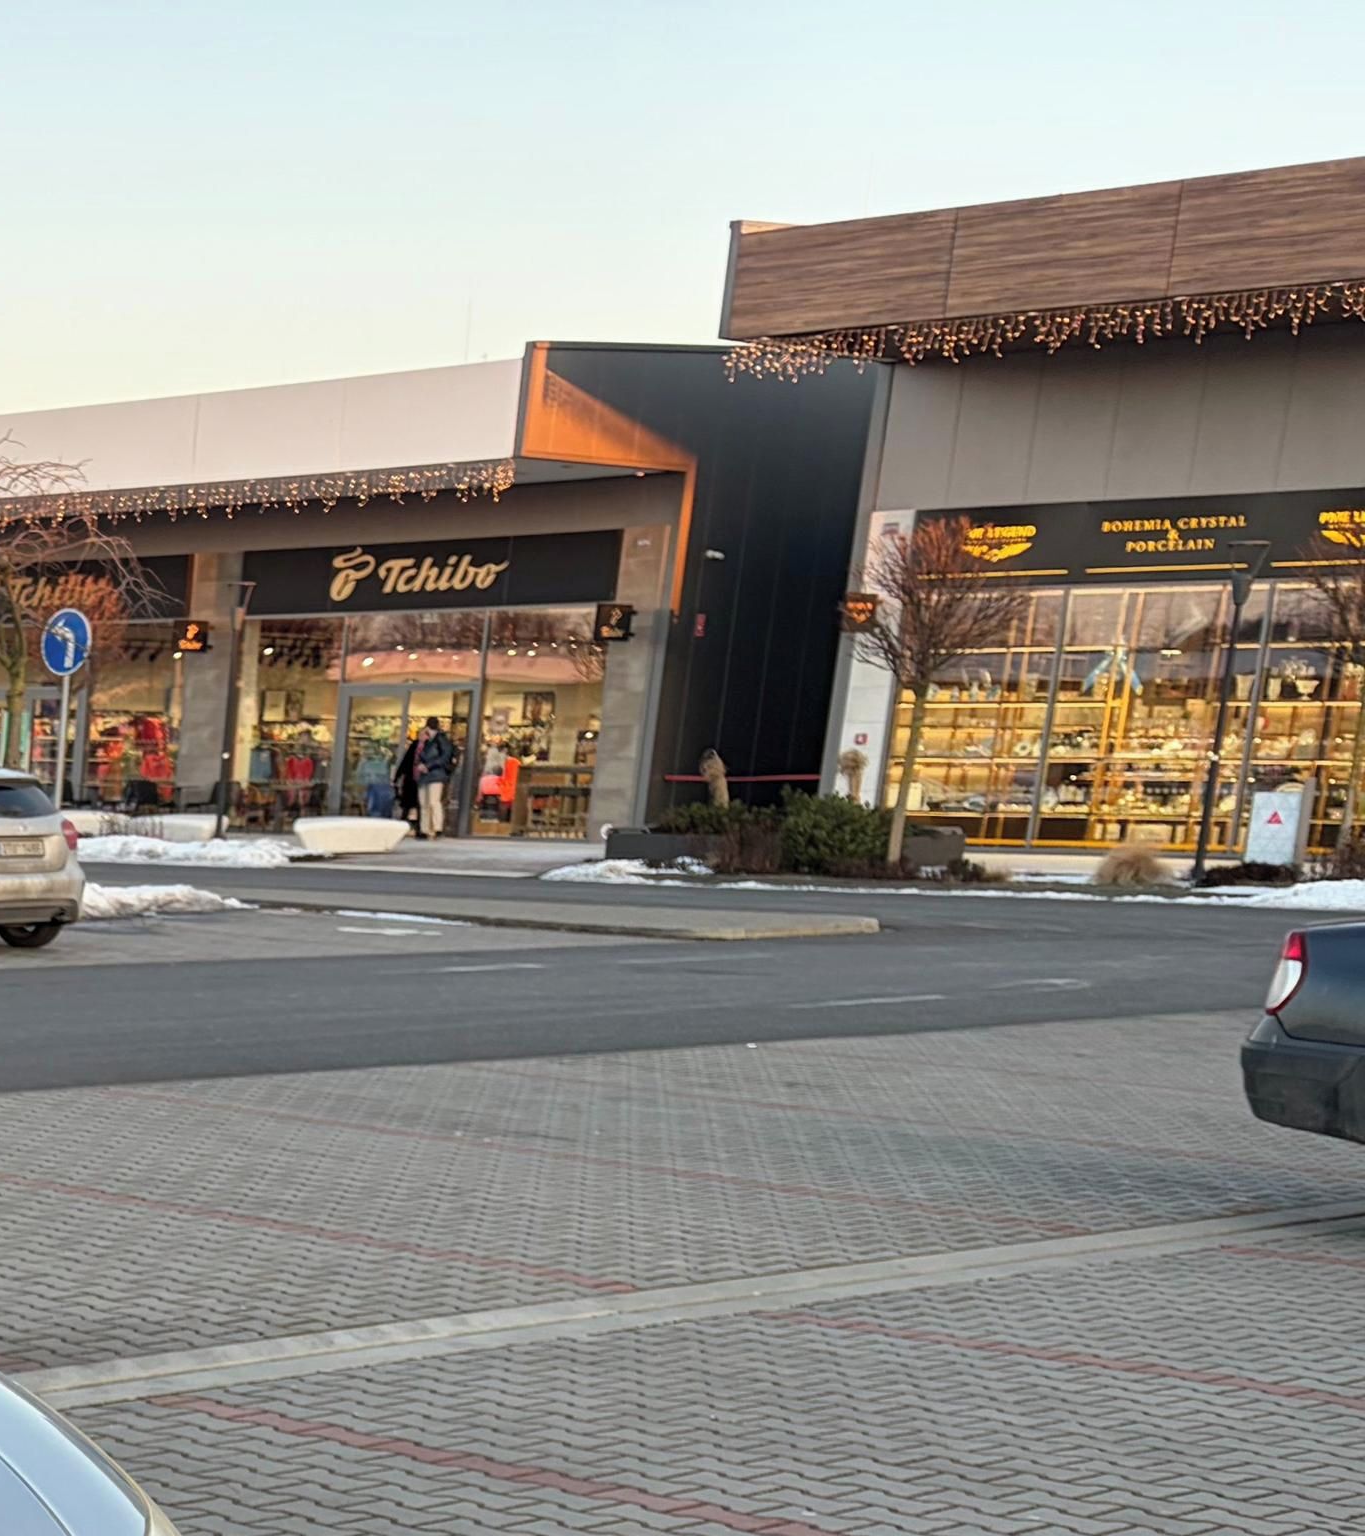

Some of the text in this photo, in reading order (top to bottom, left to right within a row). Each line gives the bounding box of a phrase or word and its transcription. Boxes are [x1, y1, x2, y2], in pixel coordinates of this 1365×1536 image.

[1101, 515, 1247, 533] BOHEMIA CRYSTAL
[1125, 538, 1215, 552] PORCELAIN
[378, 554, 510, 594] Tchibo
